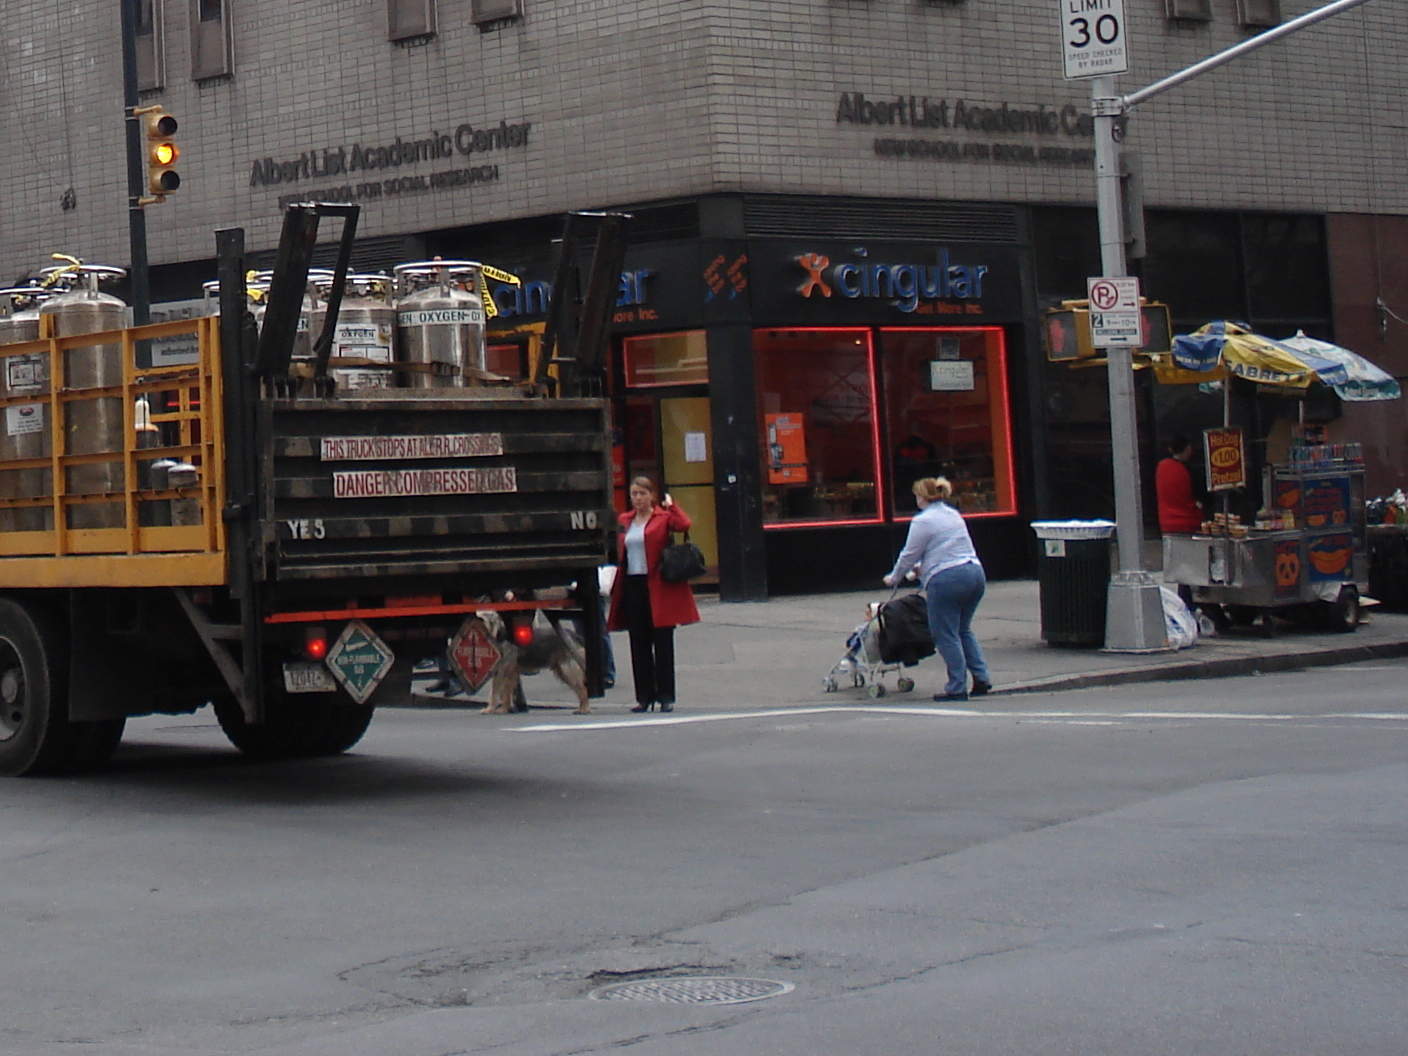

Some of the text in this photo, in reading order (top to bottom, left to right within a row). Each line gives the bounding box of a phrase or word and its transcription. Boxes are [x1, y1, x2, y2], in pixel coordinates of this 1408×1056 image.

[1069, 14, 1119, 48] 30
[1068, 52, 1090, 61] SPEED
[1079, 58, 1113, 69] BY RADAR
[837, 92, 907, 126] Albert
[910, 95, 949, 128] List
[953, 98, 1058, 134] Academic
[250, 120, 532, 187] Albert List Academic Center
[874, 138, 906, 157] NEW
[907, 139, 960, 159] SCHOOL
[963, 141, 989, 159] FOR
[992, 143, 1038, 163] SOCIAL
[356, 181, 382, 199] FOR
[383, 174, 428, 195] SOCIAL
[430, 164, 499, 189] RESEARCH
[834, 247, 989, 313] cingular
[420, 310, 465, 323] OXYGEN
[638, 307, 659, 321] Inc.
[916, 301, 984, 315] Get More Inc.
[341, 330, 375, 339] OXYGEN
[324, 439, 345, 460] THIS
[345, 438, 376, 459] TRUCK
[376, 437, 406, 458] STOPS
[407, 437, 419, 457] AT
[1210, 433, 1239, 447] Hot Dog
[337, 467, 513, 496] DANGER COMPRESSED GAS
[1212, 469, 1242, 484] Pretzel
[287, 511, 598, 540] YES NO
